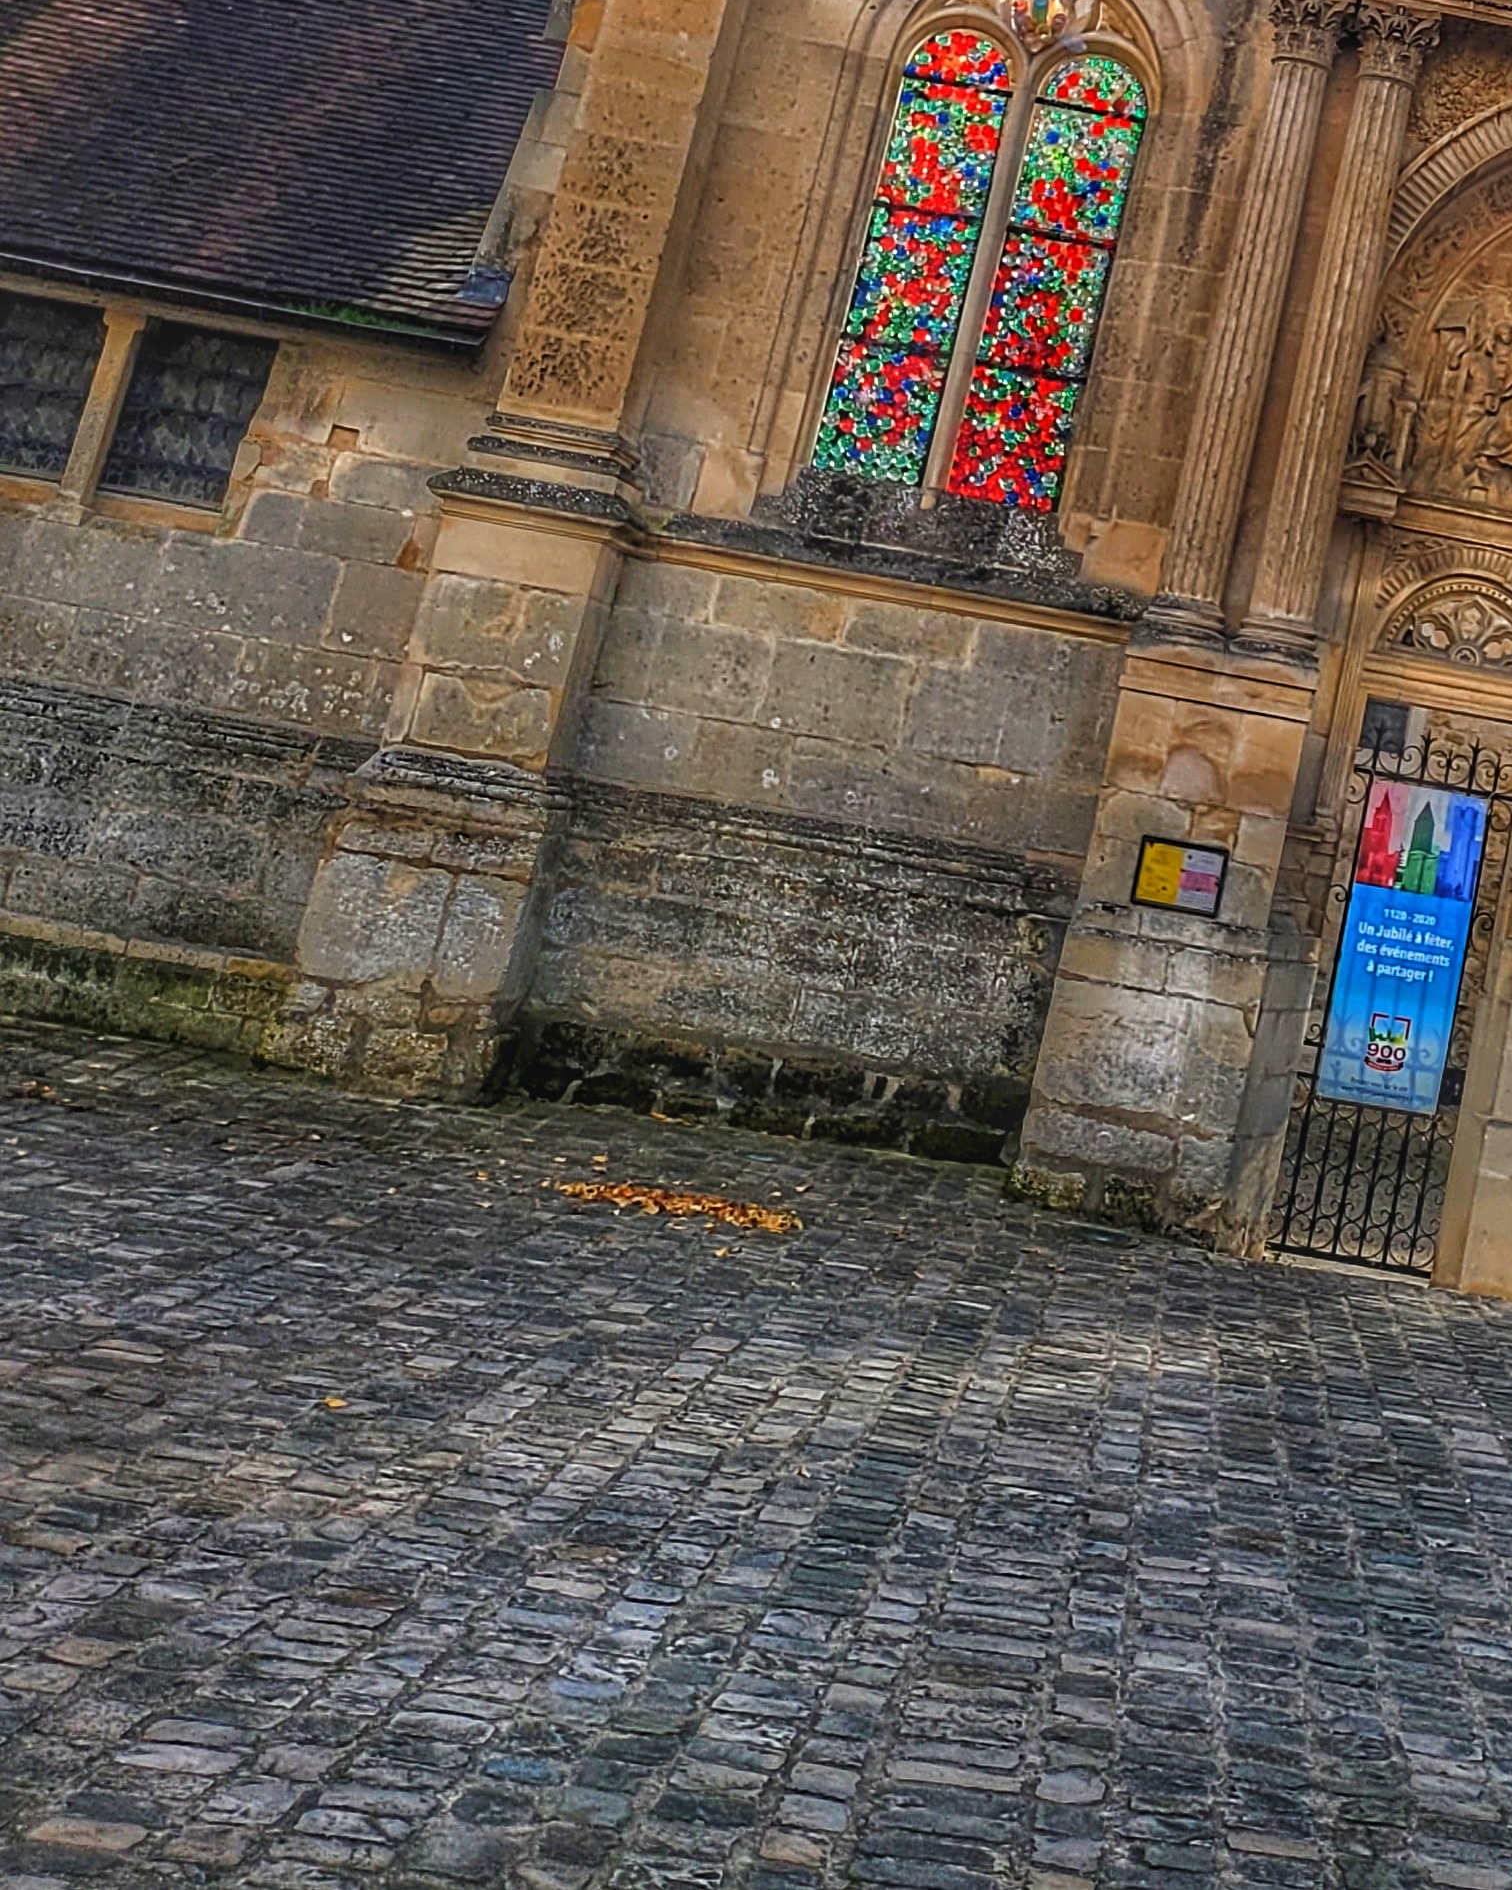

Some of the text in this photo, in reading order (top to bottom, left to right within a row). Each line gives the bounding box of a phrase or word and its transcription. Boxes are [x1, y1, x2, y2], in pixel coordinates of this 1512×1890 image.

[1383, 908, 1407, 921] 1120
[1412, 913, 1436, 926] 2020
[1358, 921, 1455, 951] Un Jubilé à fêter,
[1356, 939, 1451, 967] des événements
[1366, 959, 1374, 972] à
[1375, 963, 1427, 983] partager
[1367, 1043, 1406, 1061] 900
